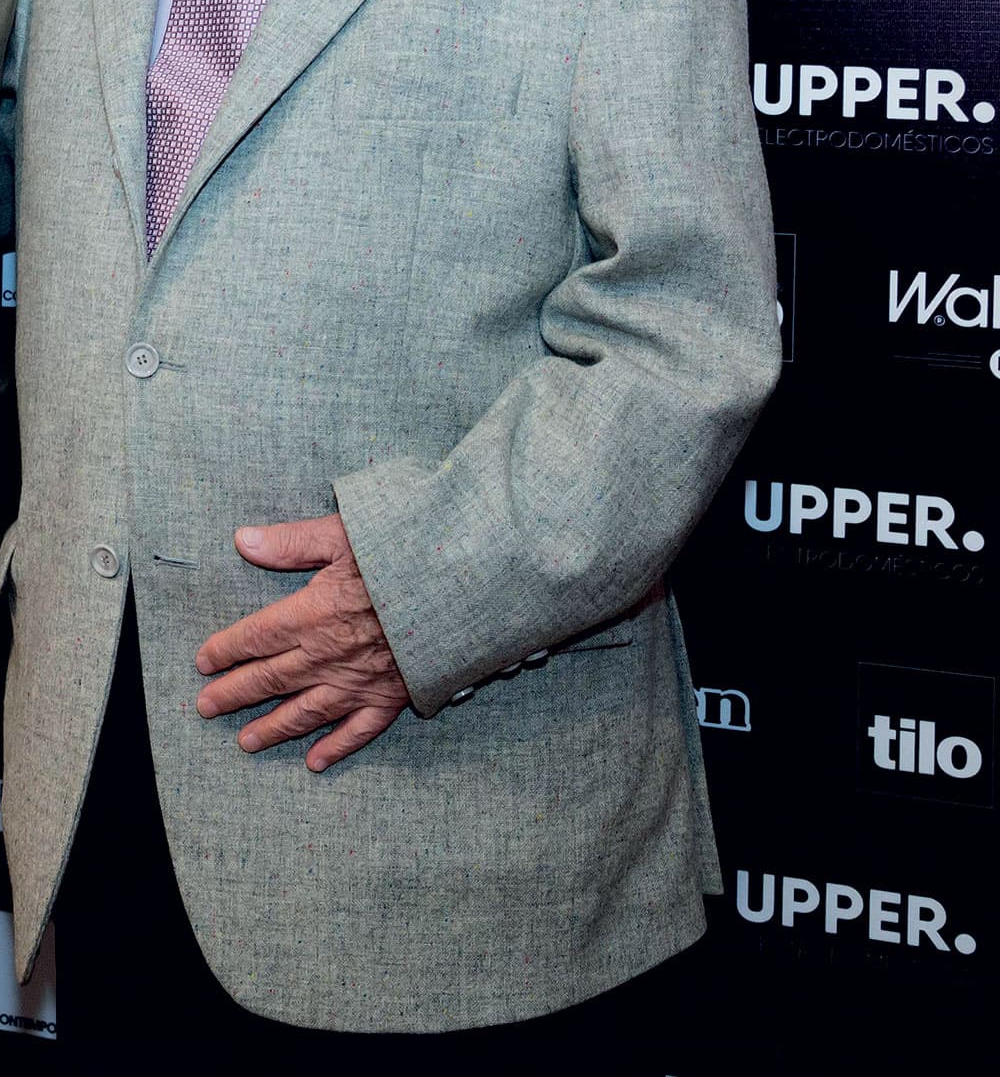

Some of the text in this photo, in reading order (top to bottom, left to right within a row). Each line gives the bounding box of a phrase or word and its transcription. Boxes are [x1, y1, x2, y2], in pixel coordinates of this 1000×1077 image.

[753, 62, 996, 124] UPPER.
[757, 128, 994, 154] LECTRODOMÉSTICOS
[744, 479, 985, 553] UPPER.
[867, 715, 983, 780] tilo
[736, 869, 977, 956] UPPER.
